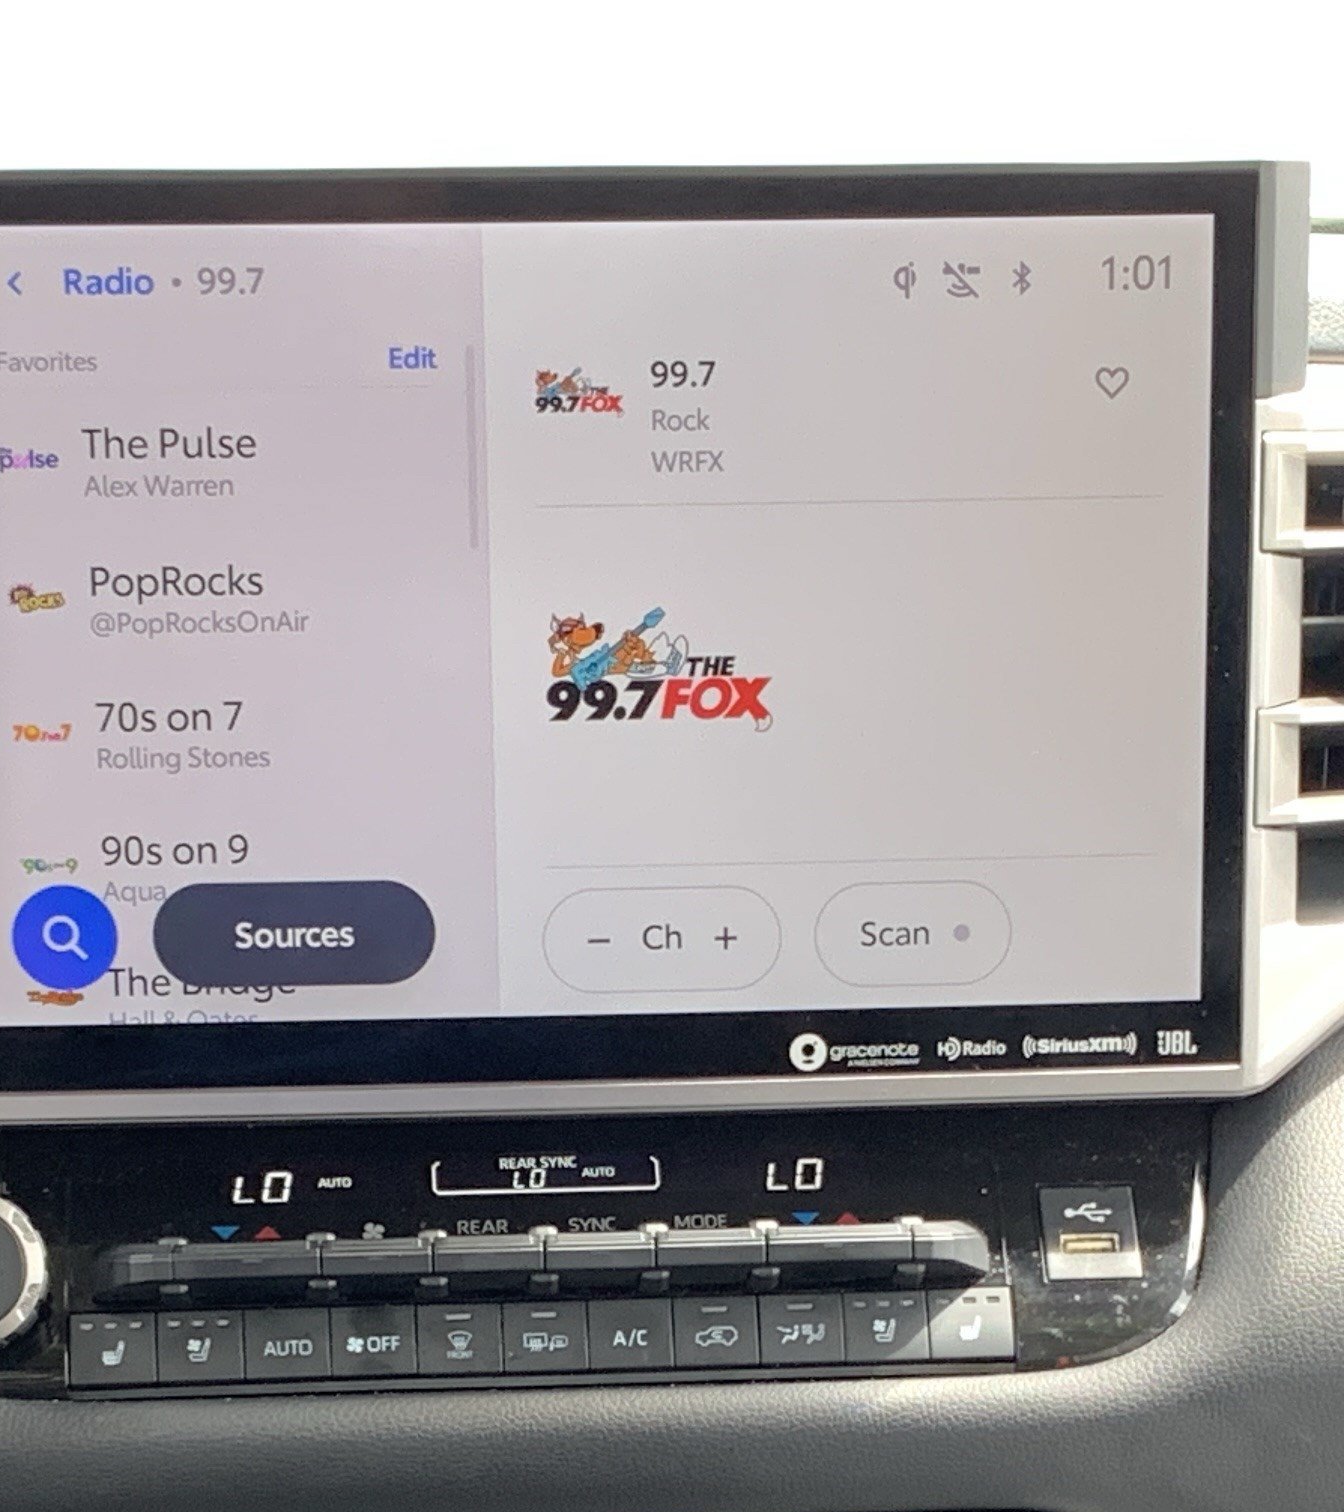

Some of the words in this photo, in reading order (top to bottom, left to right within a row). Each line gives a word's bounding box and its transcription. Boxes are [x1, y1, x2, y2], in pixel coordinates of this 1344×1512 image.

[63, 267, 154, 296] Radio
[196, 267, 264, 295] 99.7
[1102, 255, 1173, 291] 1:01
[388, 346, 438, 369] Edit
[650, 361, 716, 388] 99.7
[535, 397, 580, 413] 99.7
[579, 395, 624, 414] FOX
[651, 409, 711, 432] Rock
[81, 427, 149, 460] The
[159, 426, 257, 460] Pulse
[651, 450, 724, 472] WRFX
[84, 474, 138, 498] Alex
[144, 474, 234, 498] Warren
[89, 565, 264, 604] PopRocks
[89, 610, 309, 641] @PopRocksOnAir
[686, 655, 735, 676] THE
[546, 680, 662, 722] 99.7
[660, 676, 773, 721] FOX
[95, 702, 157, 732] 70s
[167, 709, 212, 731] on
[223, 701, 243, 731] 7
[97, 747, 181, 774] Rolling
[188, 746, 271, 768] Stones
[101, 835, 163, 866] 90s
[173, 842, 218, 865] on
[228, 833, 249, 864] 9
[102, 881, 167, 909] Aqua
[234, 921, 355, 950] Sources
[641, 923, 683, 951] Ch
[860, 919, 930, 948] Scan
[108, 968, 171, 997] The
[830, 1043, 919, 1062] gracenote
[962, 1039, 1006, 1056] Radio
[1158, 1030, 1198, 1055] JBL
[499, 1158, 536, 1171] REAR
[540, 1155, 577, 1169] SYNC
[582, 1166, 616, 1178] AUTO
[317, 1176, 353, 1188] AUTO
[456, 1219, 509, 1235] REAR
[568, 1216, 616, 1232] SYNC
[673, 1213, 728, 1230] MODE
[263, 1339, 314, 1357] AUTO
[366, 1336, 401, 1353] OFF
[613, 1329, 649, 1347] A/C
